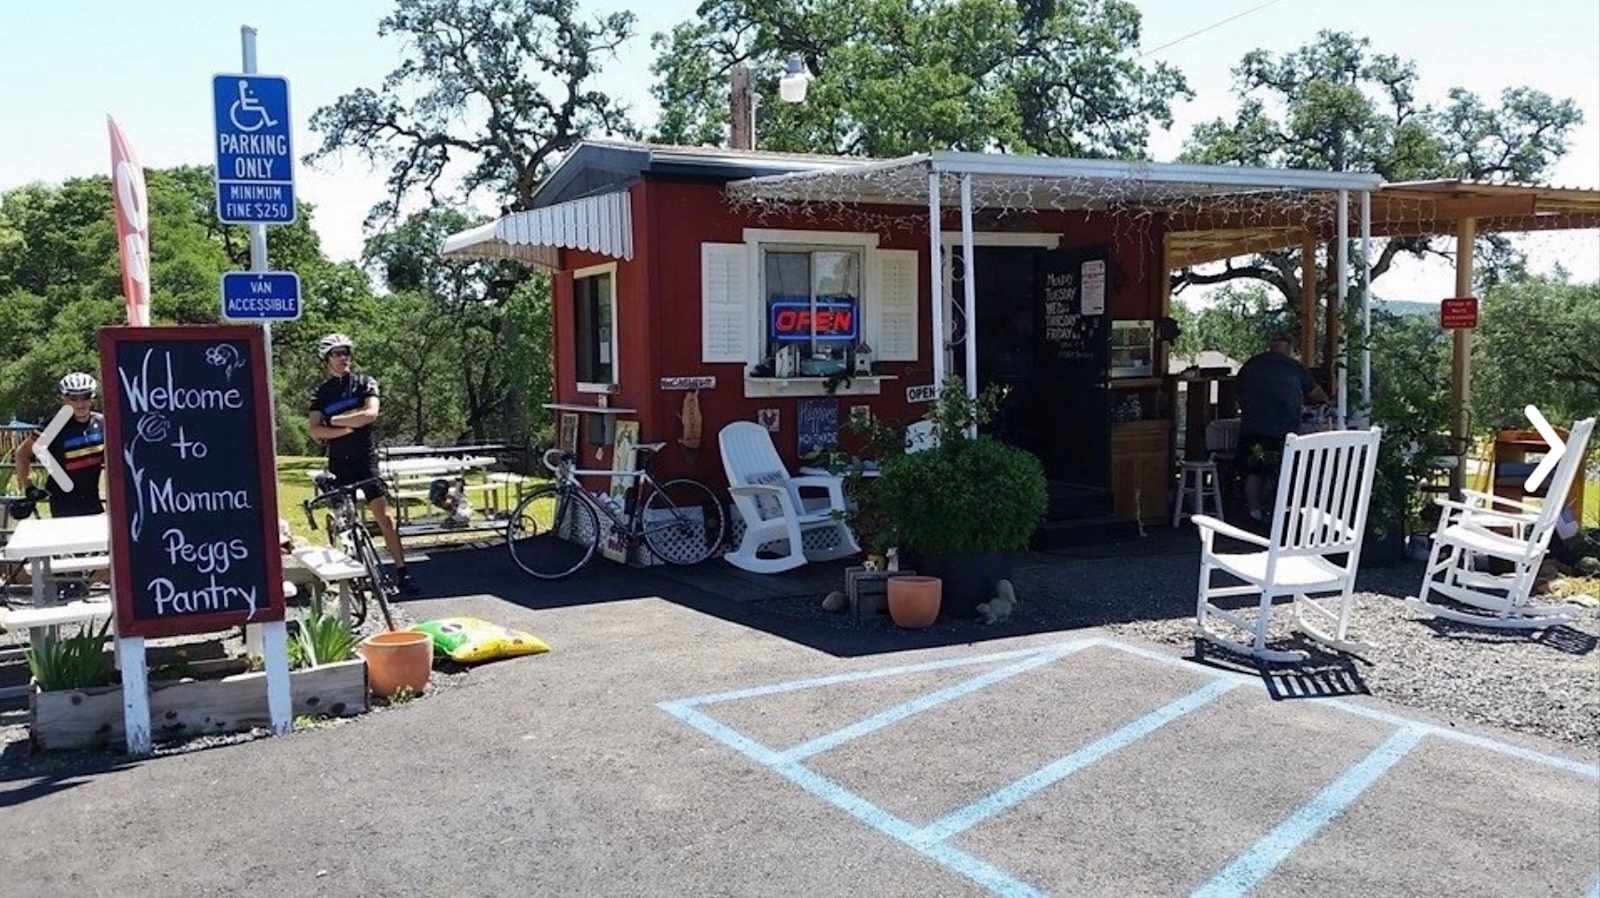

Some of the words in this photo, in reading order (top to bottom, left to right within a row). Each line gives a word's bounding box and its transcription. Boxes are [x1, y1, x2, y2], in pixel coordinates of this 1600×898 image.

[220, 133, 287, 156] PARKING
[235, 157, 274, 179] ONLY
[230, 185, 282, 200] MINIMUM
[226, 203, 251, 218] FINE
[256, 203, 287, 219] $250
[250, 281, 272, 294] VAN
[228, 298, 296, 312] ACCESSIBLE
[775, 311, 852, 332] OPEN
[118, 348, 243, 413] Welcome
[909, 386, 936, 400] OPEN
[170, 425, 208, 459] to
[150, 477, 252, 514] Momma
[162, 528, 249, 573] Peggs
[147, 574, 256, 620] Pantry
